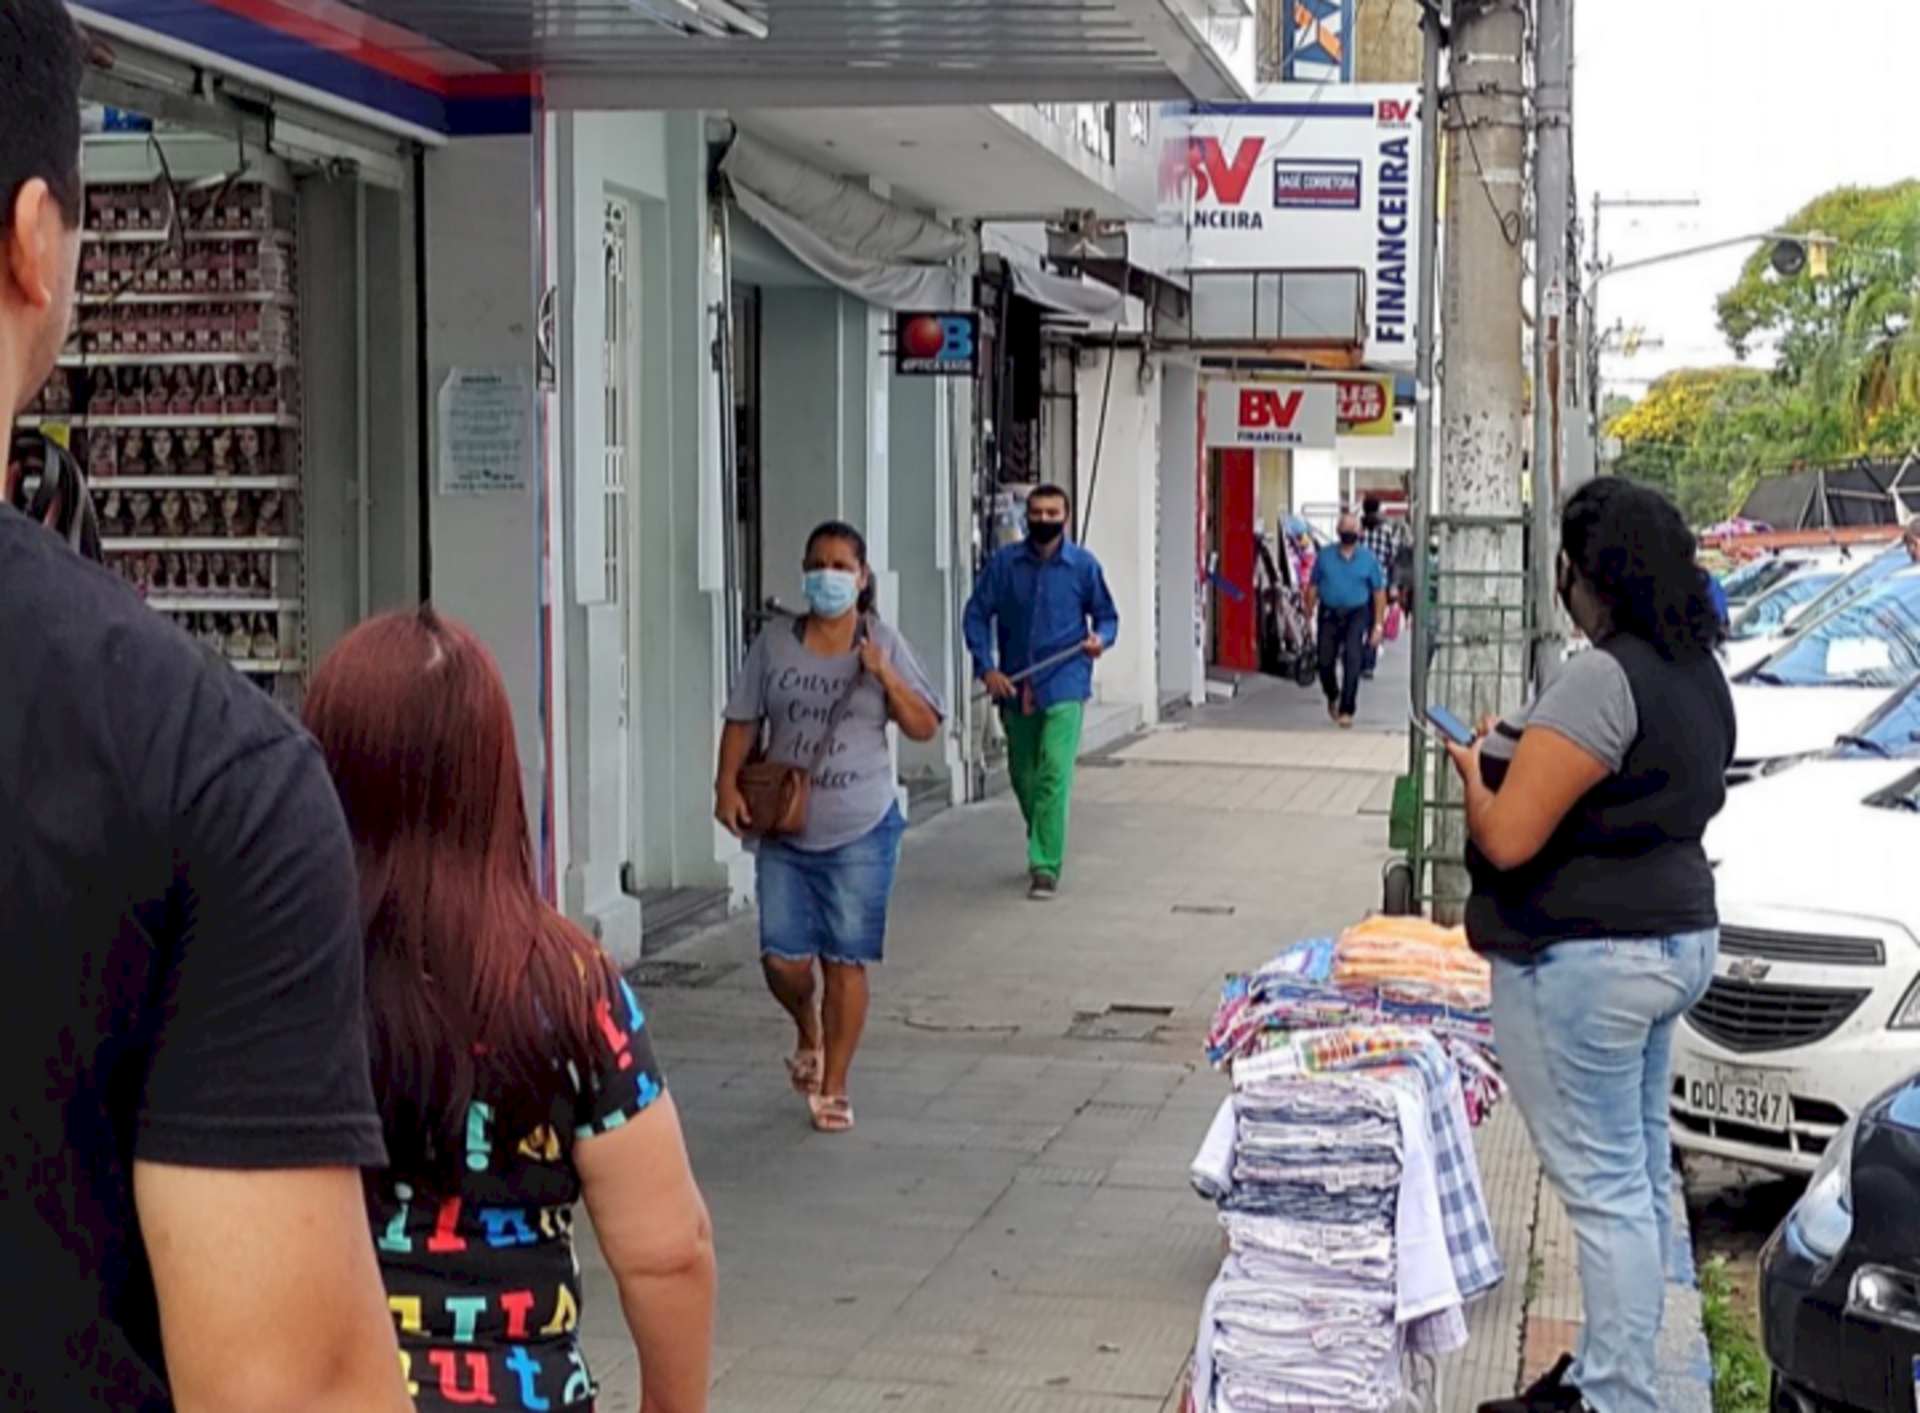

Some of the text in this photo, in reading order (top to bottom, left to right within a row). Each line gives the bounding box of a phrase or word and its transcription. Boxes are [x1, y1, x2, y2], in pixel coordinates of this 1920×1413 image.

[1378, 99, 1412, 121] BV
[1193, 210, 1263, 229] NCEIRA
[1376, 136, 1409, 343] FINANCEIRA
[1238, 388, 1304, 429] BV
